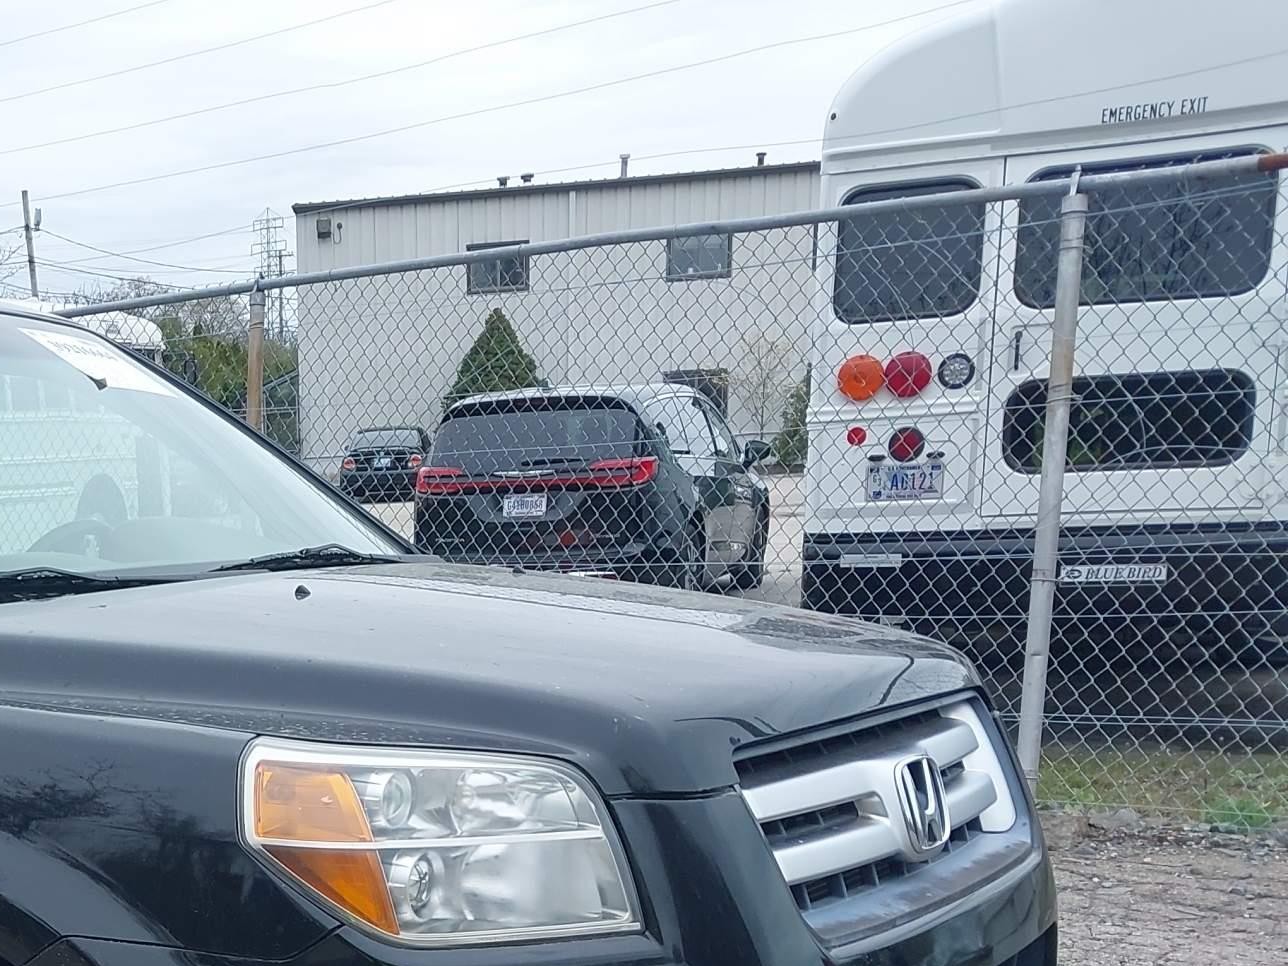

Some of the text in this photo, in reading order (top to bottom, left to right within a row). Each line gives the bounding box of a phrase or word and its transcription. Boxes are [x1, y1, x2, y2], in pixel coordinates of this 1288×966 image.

[1101, 96, 1209, 124] EMERGENCY EXIT
[1085, 566, 1163, 580] BLUE BIRD
